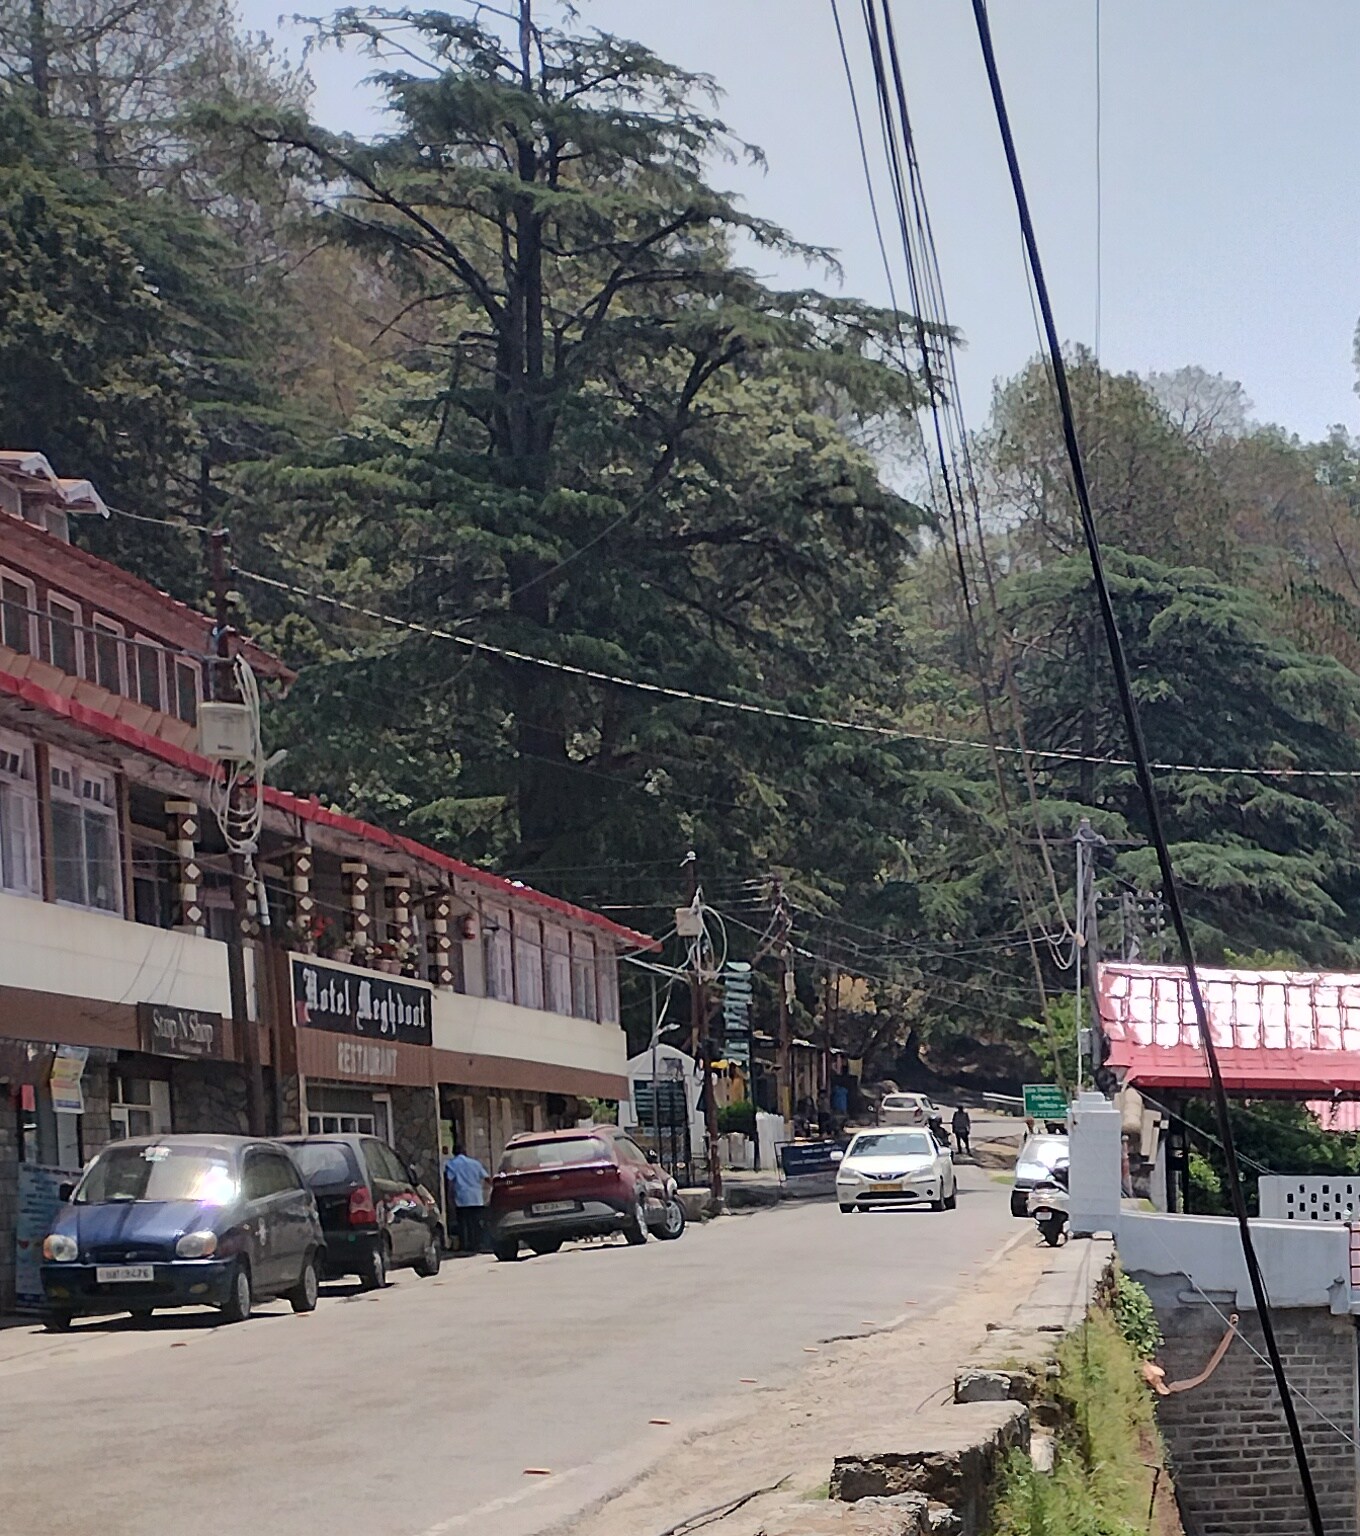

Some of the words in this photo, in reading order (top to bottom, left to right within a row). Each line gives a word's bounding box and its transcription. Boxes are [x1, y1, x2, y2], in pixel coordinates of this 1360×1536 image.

[303, 967, 350, 1022] Hotel
[356, 980, 425, 1034] Meghdoot
[153, 1008, 177, 1049] Stop
[189, 1012, 213, 1053] Shop
[338, 1042, 397, 1077] RESTAURANT
